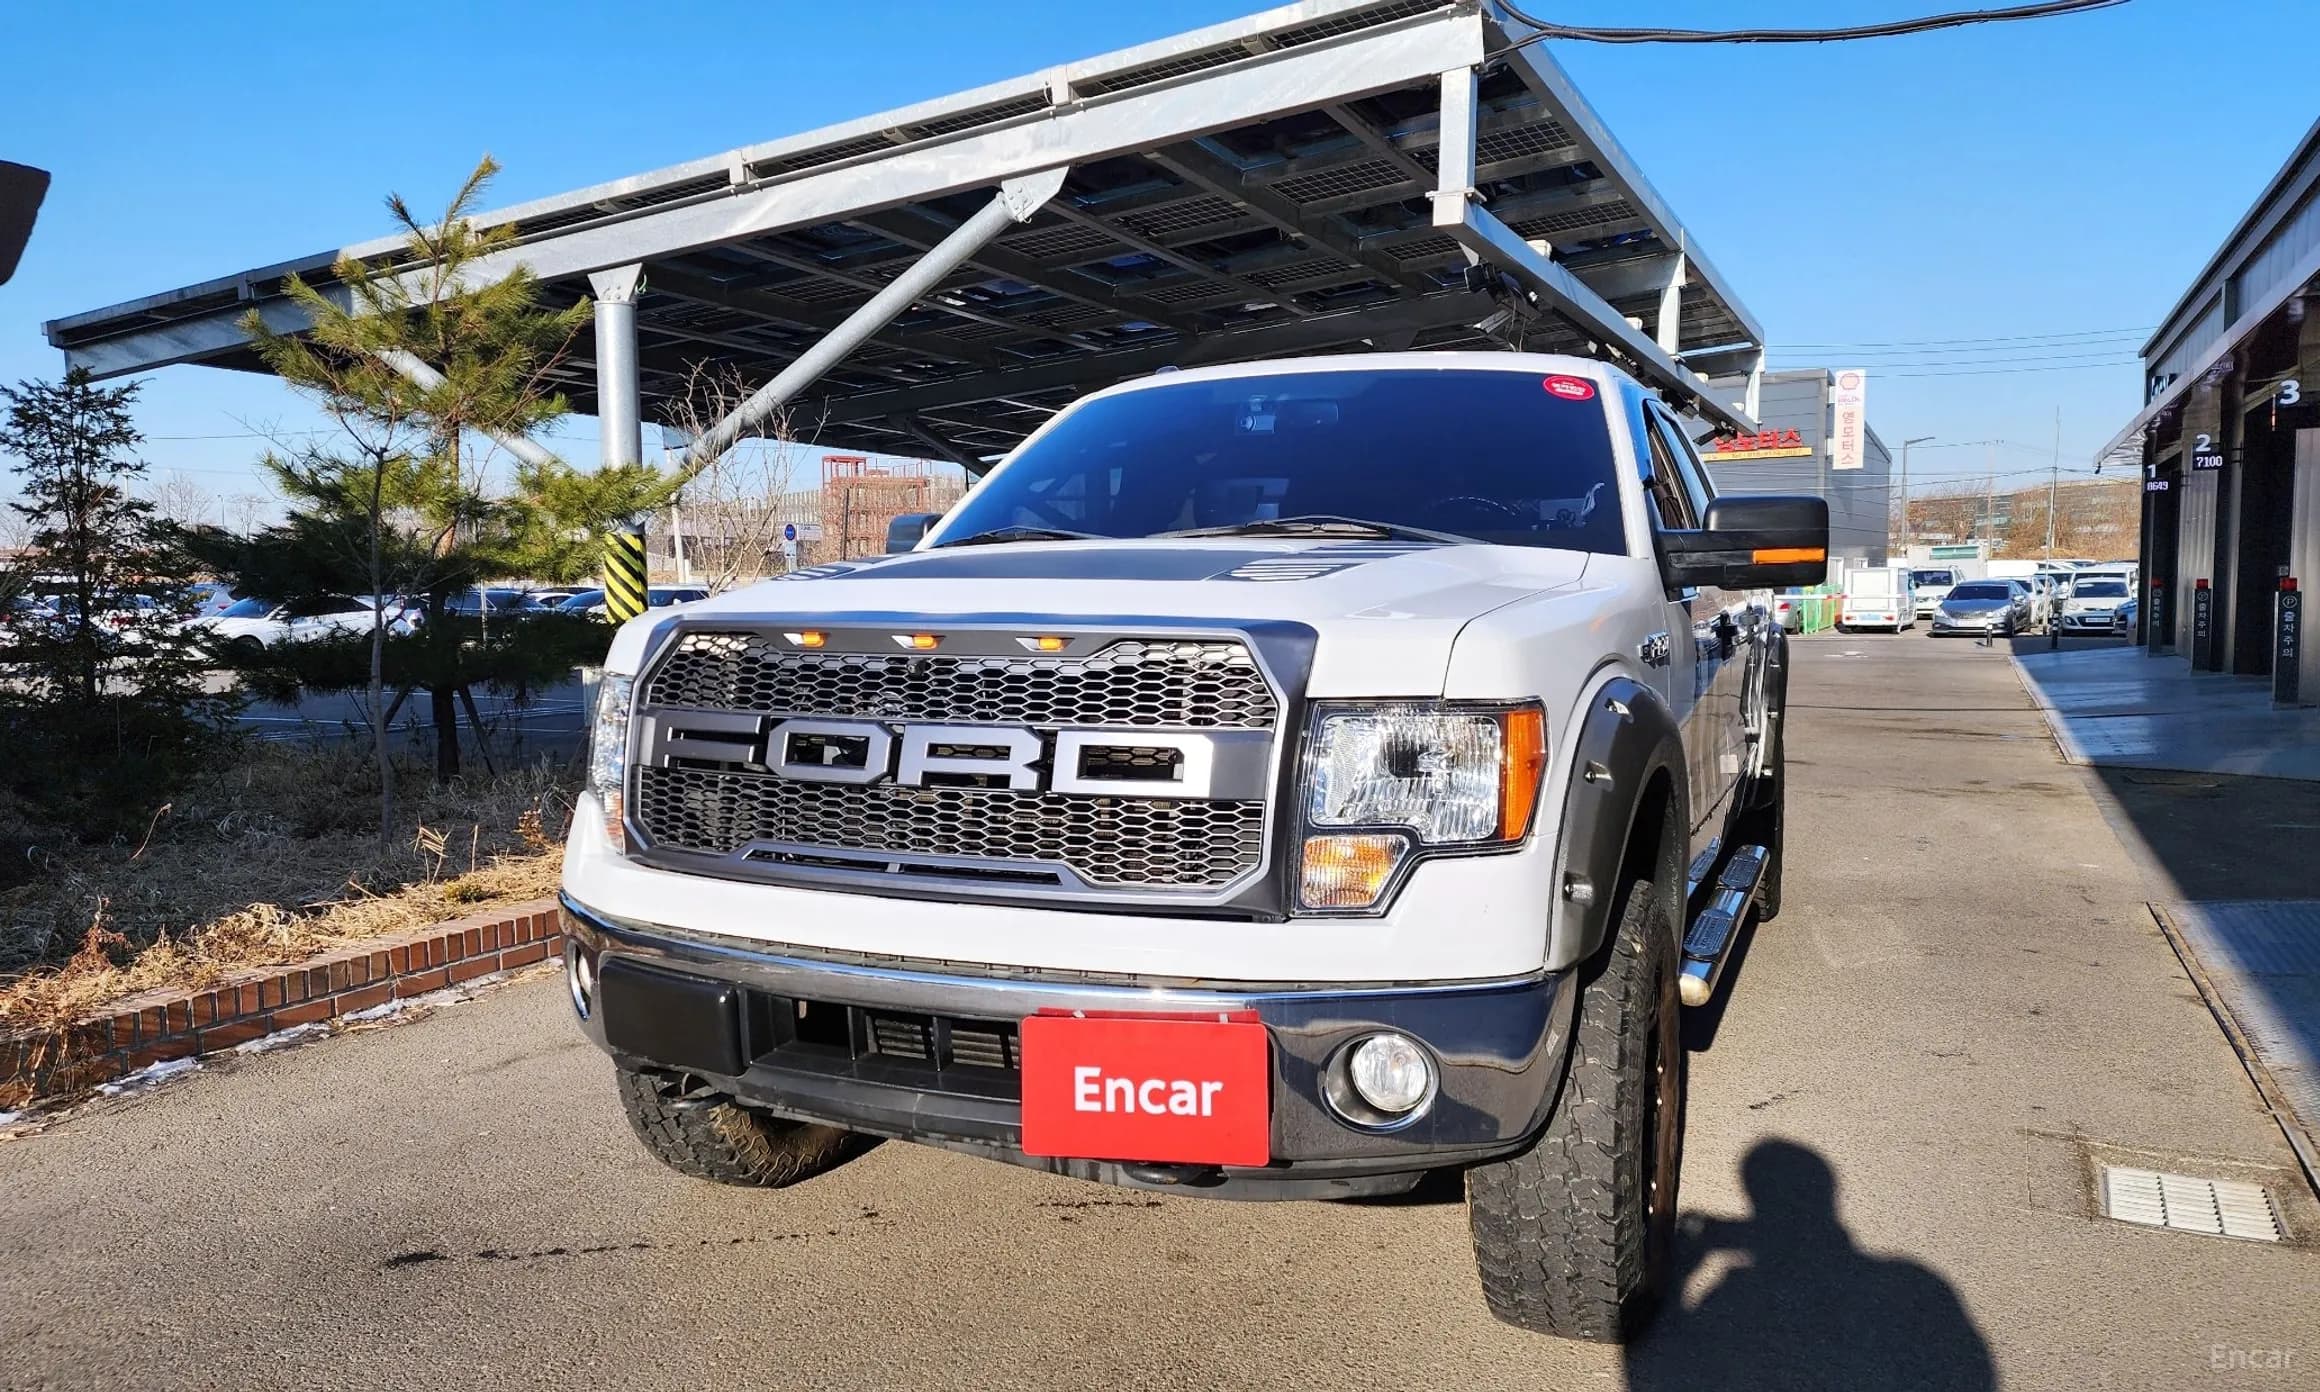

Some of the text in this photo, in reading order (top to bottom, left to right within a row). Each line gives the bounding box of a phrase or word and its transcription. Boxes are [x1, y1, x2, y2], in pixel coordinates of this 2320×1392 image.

[2279, 379, 2301, 405] 3
[2195, 433, 2212, 452] 2
[2147, 464, 2157, 479] 1
[652, 708, 1214, 799] FORD
[1074, 1065, 1223, 1117] Encar
